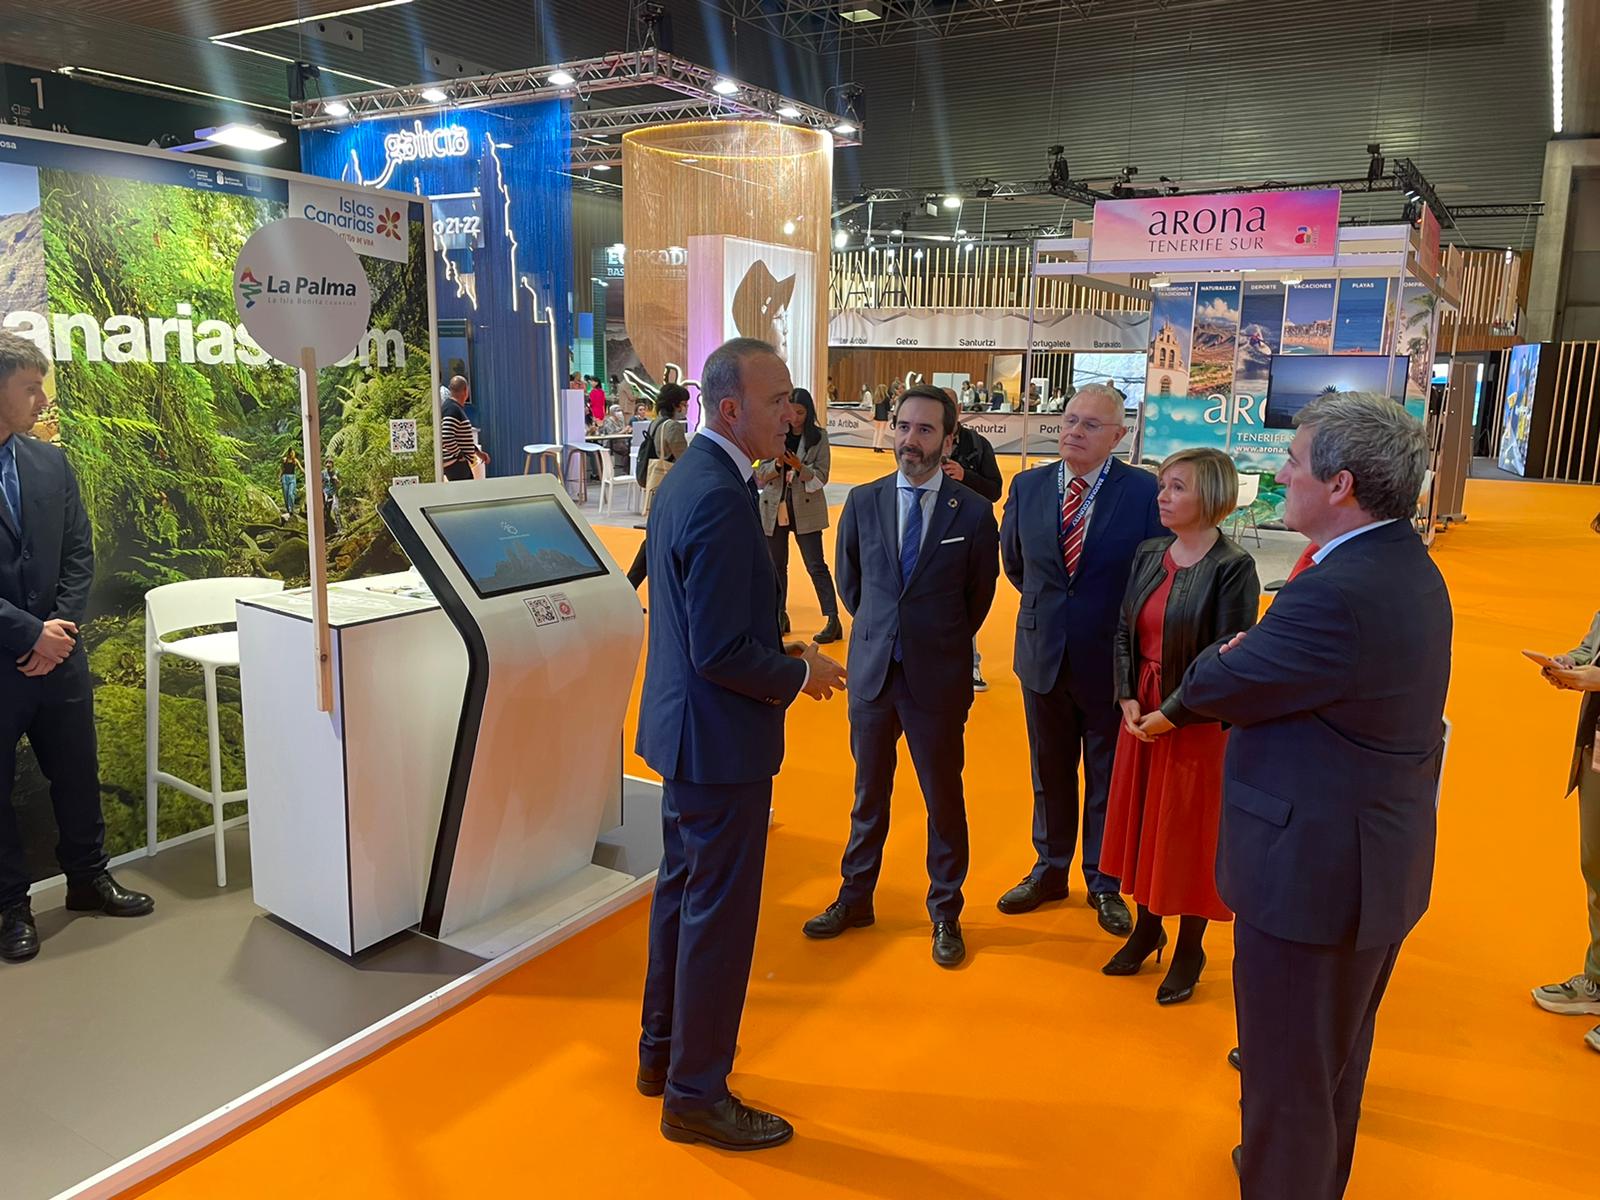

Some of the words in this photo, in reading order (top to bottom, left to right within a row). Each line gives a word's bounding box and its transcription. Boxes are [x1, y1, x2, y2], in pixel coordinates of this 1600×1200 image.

[30, 77, 44, 110] 1
[384, 119, 469, 164] galicia
[339, 196, 375, 219] Islas
[303, 204, 375, 234] Canarias
[445, 216, 481, 235] 21-22
[1148, 238, 1223, 253] TENERIFE
[1230, 236, 1264, 250] SUR
[267, 275, 290, 294] La
[295, 276, 356, 297] Palma
[895, 337, 919, 346] Getxo
[959, 338, 996, 347] Santurtzi
[1031, 340, 1071, 349] ortugalete
[1236, 432, 1285, 443] TENERIFE
[1235, 445, 1288, 454] www.arona.
